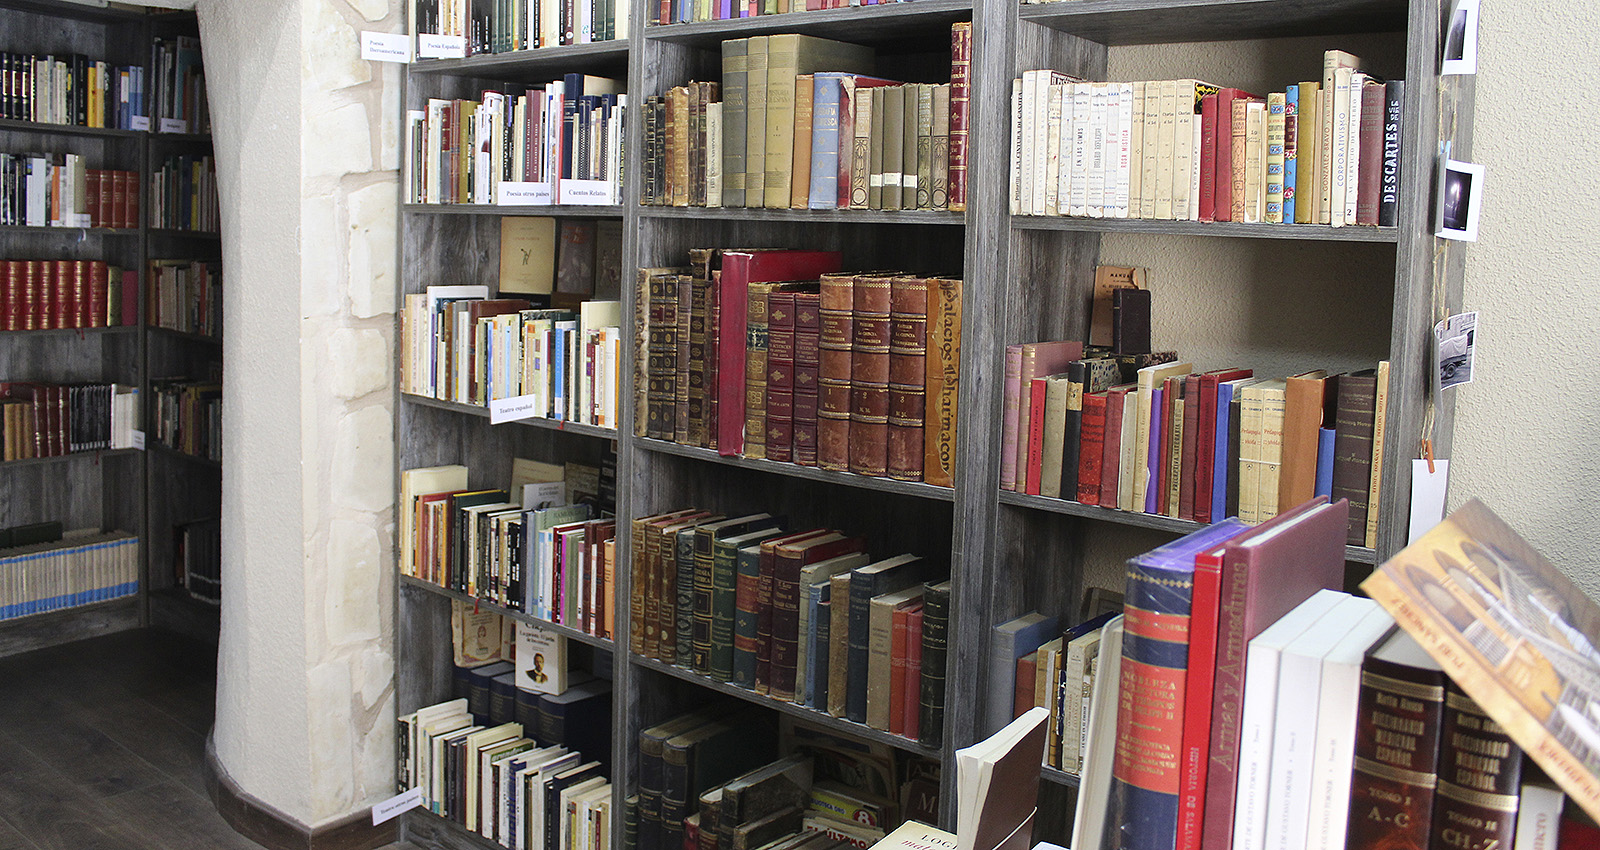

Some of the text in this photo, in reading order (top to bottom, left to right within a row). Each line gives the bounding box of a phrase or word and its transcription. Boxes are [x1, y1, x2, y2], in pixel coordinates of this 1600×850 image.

[1076, 127, 1084, 145] CIMAS
[1323, 127, 1331, 151] BRAVO
[1204, 117, 1213, 199] GLORIAS NACIONALES
[1336, 112, 1346, 187] CORPORATIVISMO
[1075, 159, 1082, 167] EN
[1120, 154, 1128, 168] ROSA
[1383, 123, 1399, 204] DESCARTES
[1346, 208, 1353, 217] 2
[939, 280, 960, 361] Palacios
[1171, 456, 1180, 492] PRECEPTIVA
[1211, 562, 1249, 772] Armas y Armaduras
[1123, 671, 1177, 691] NOBLEZA
[1129, 683, 1176, 700] LECTURA
[1122, 690, 1176, 710] EN TIEMPOS
[1133, 703, 1164, 719] FELIPE
[1372, 711, 1425, 736] DICCIONARIO
[1452, 732, 1510, 759] DICCIONARIO
[1190, 747, 1200, 792] HISTORIA
[917, 792, 936, 814] M
[1187, 795, 1198, 808] DE
[1368, 786, 1403, 804] TOMO
[857, 810, 871, 826] 8
[1246, 791, 1256, 825] GUSTAVO
[1446, 810, 1498, 832] TOMO II
